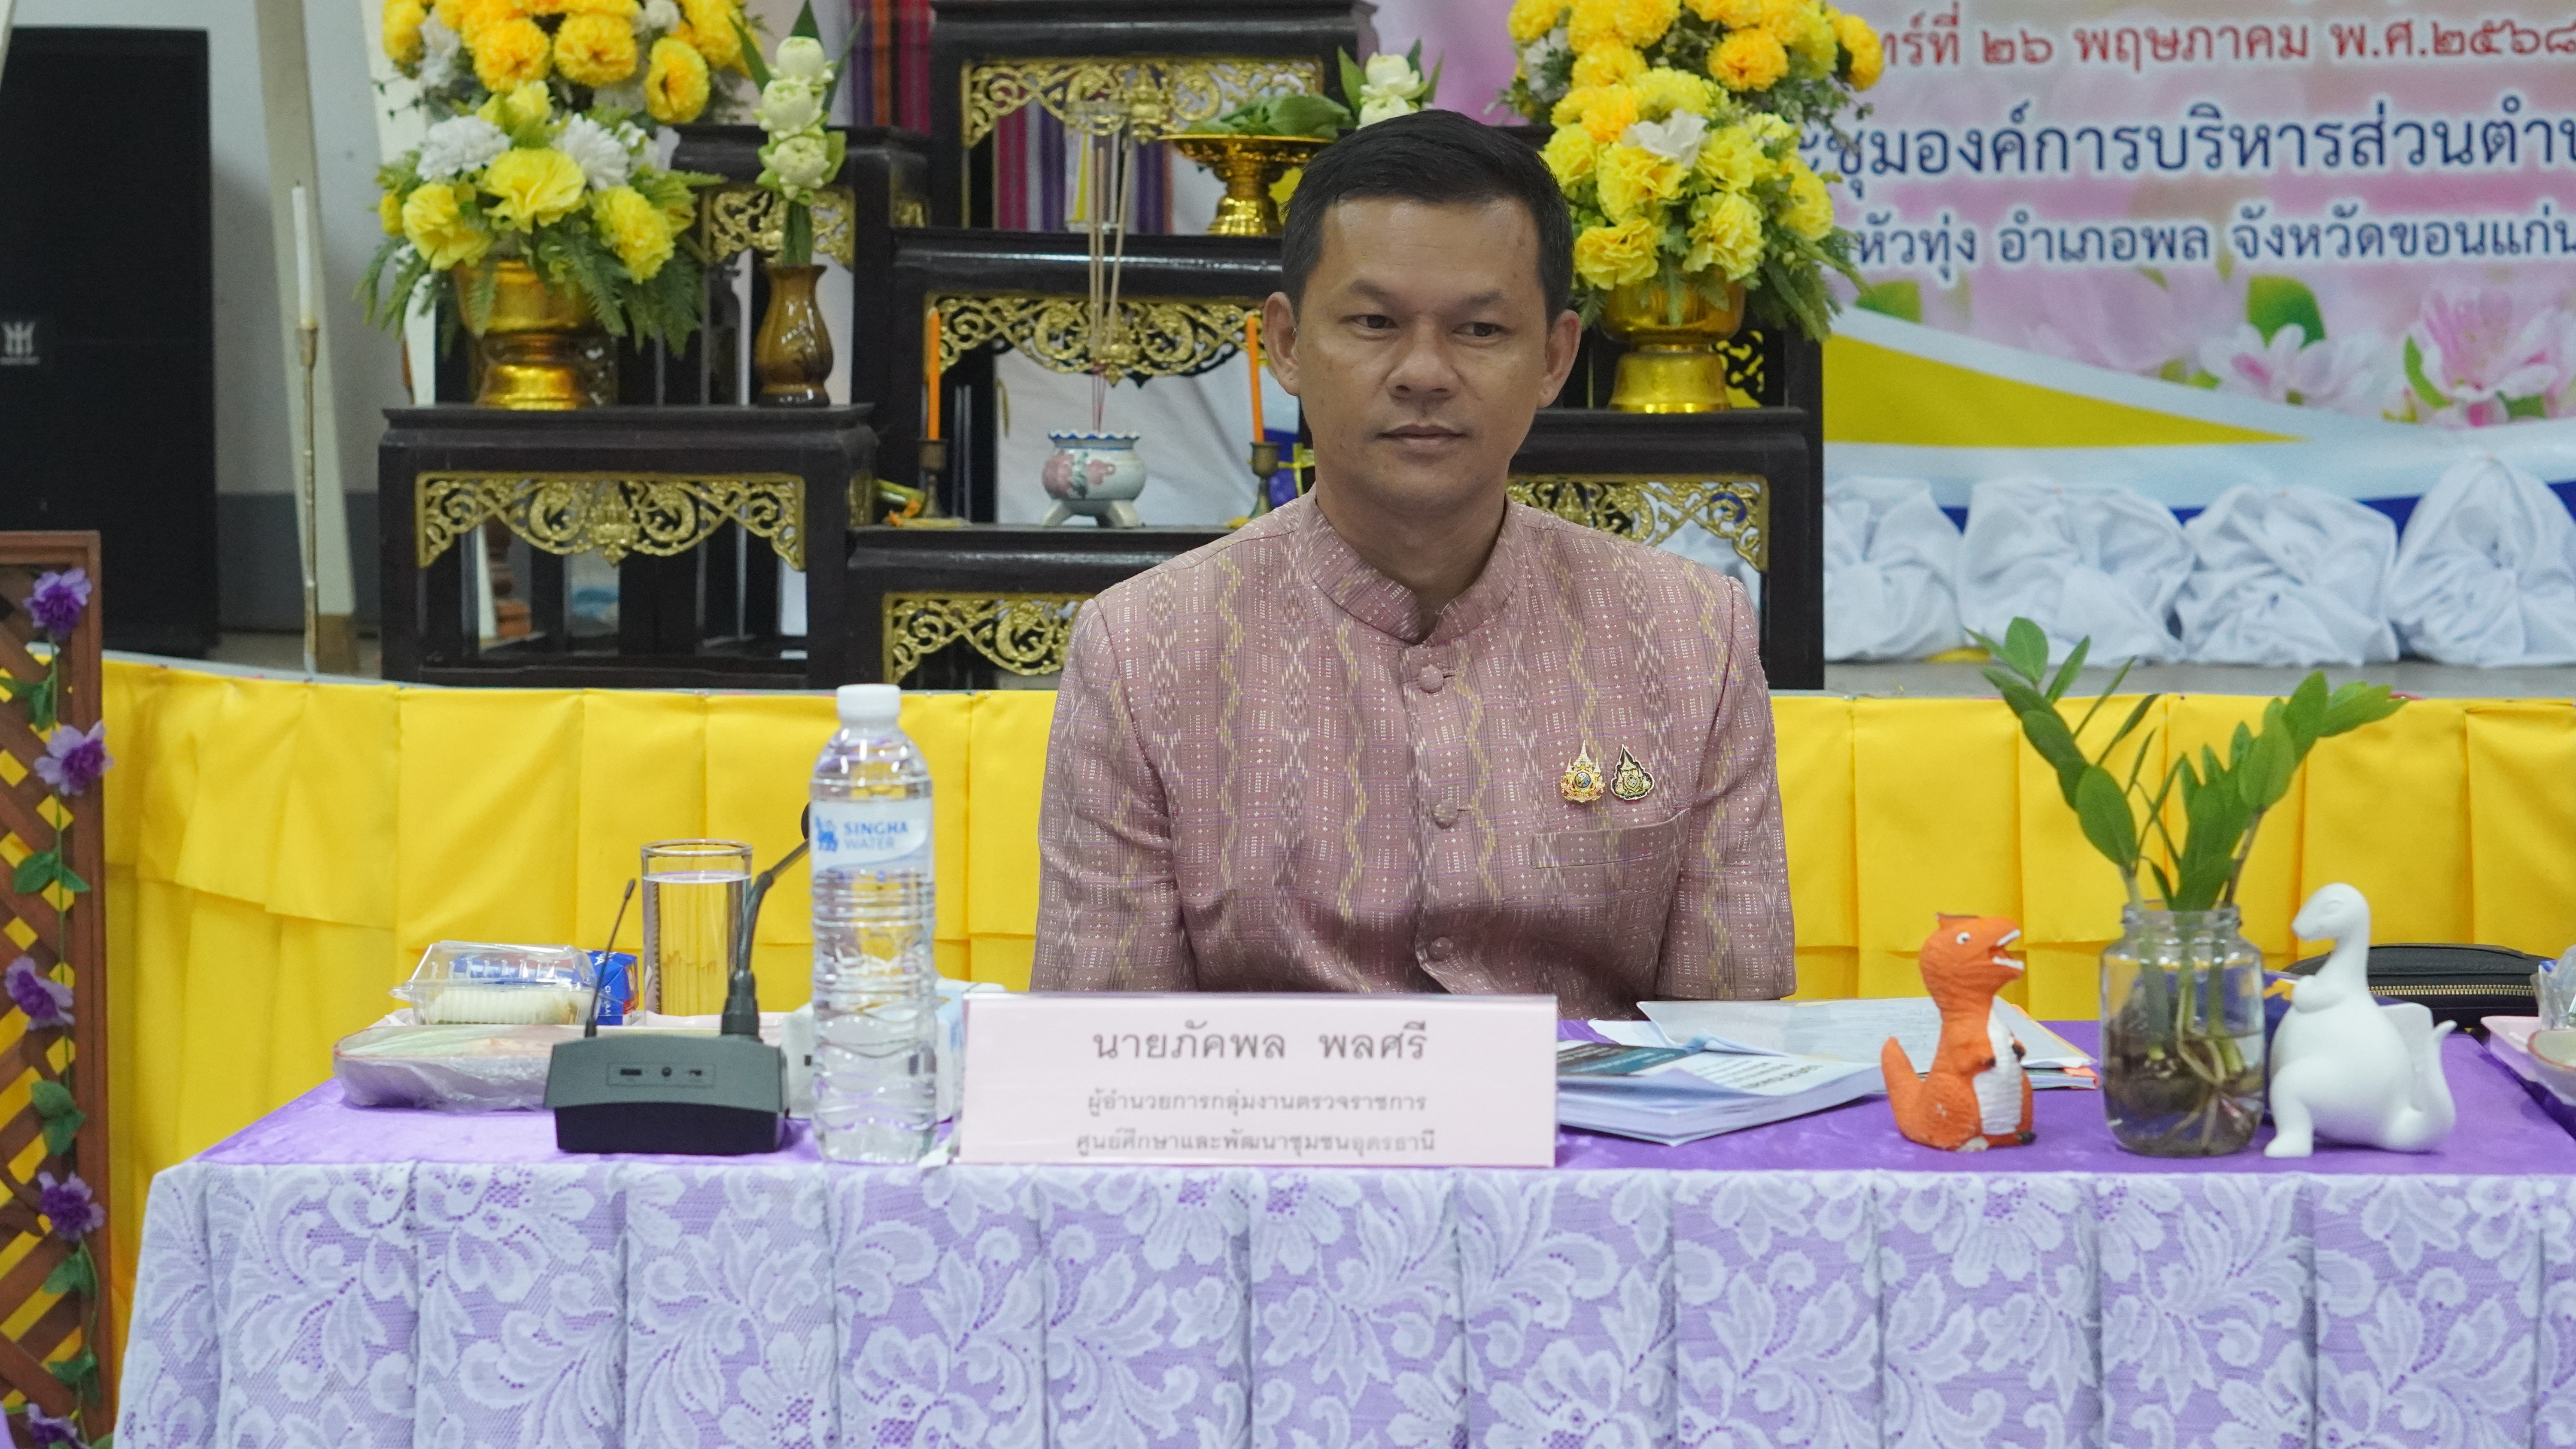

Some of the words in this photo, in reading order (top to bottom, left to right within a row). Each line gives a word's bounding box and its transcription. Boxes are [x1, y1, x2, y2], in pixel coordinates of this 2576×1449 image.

[1982, 30, 2054, 64] ๒๖
[2074, 26, 2308, 72] พฤษภาคม
[2000, 209, 2208, 262] อำเภอพล
[844, 822, 908, 834] SINGHA
[844, 837, 895, 849] WATER
[1092, 1019, 1286, 1060] นายภัคพล
[1318, 1020, 1428, 1060] พลศรี
[1088, 1088, 1427, 1117] ผู้อำนวยการกลุ่มงานตรวจราชการ
[1076, 1127, 1436, 1158] ศูนย์ศึกษาและพัฒนาชุมชนอุดรธานี
